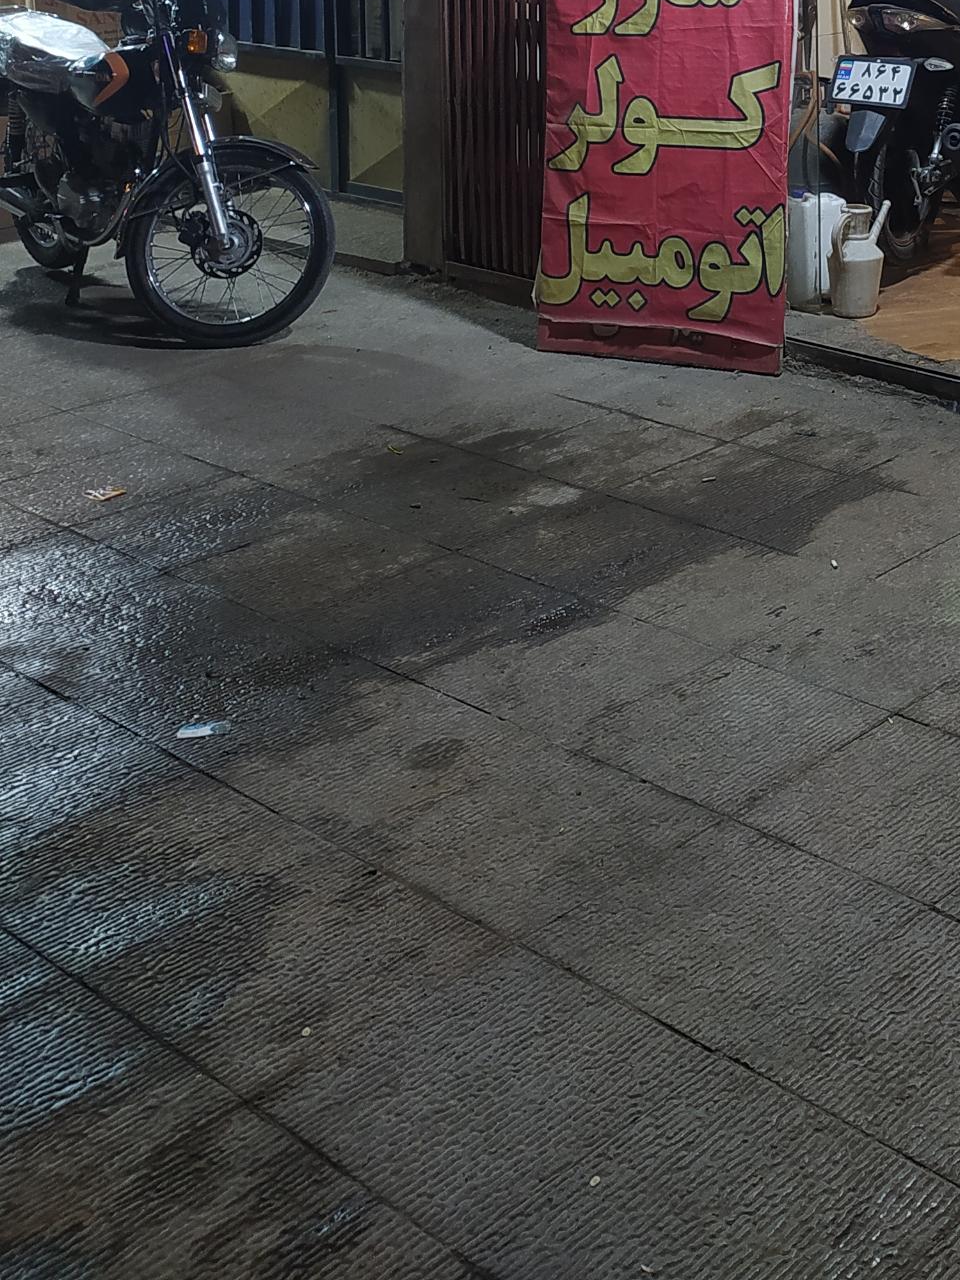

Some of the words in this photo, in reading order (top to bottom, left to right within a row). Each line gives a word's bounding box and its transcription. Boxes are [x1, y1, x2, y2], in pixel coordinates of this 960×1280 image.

[834, 82, 903, 102] ۶۶۵۳۲
[861, 62, 901, 82] ۸۶۴
[548, 53, 782, 176] کولر
[538, 193, 787, 322] اتومبیل
